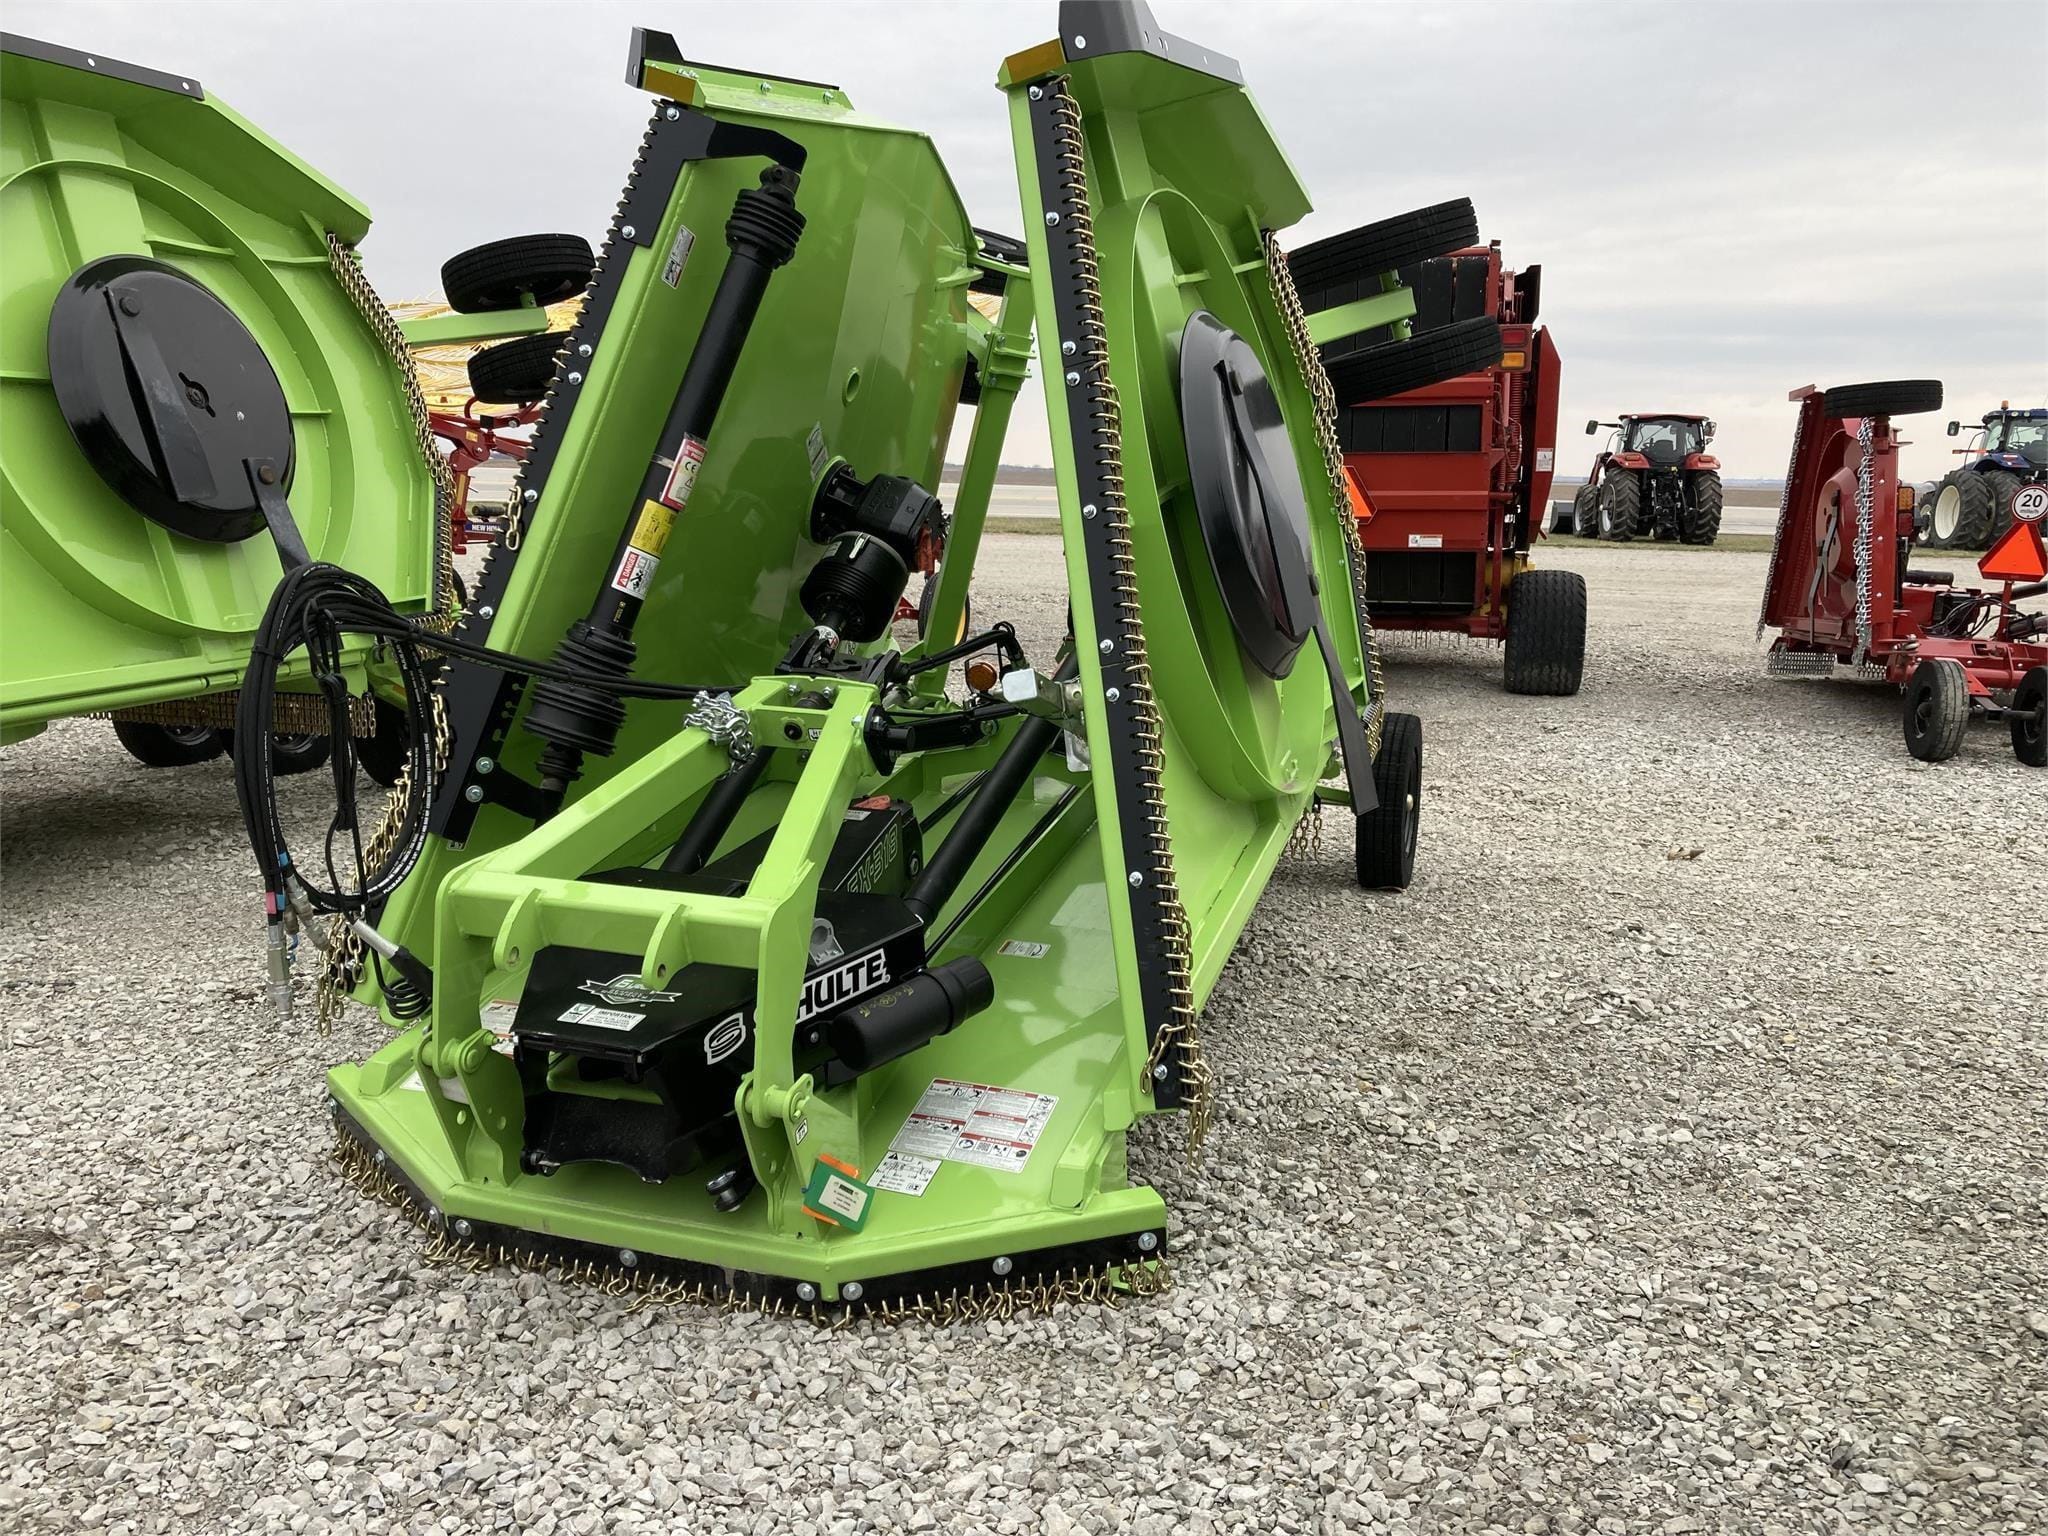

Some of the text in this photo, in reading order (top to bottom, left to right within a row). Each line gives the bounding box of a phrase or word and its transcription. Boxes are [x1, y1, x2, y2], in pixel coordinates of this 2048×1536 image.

[2021, 494, 2043, 507] 20
[622, 553, 638, 577] DANGER
[796, 949, 886, 1022] HULTE
[598, 1010, 637, 1020] IMPORTANT
